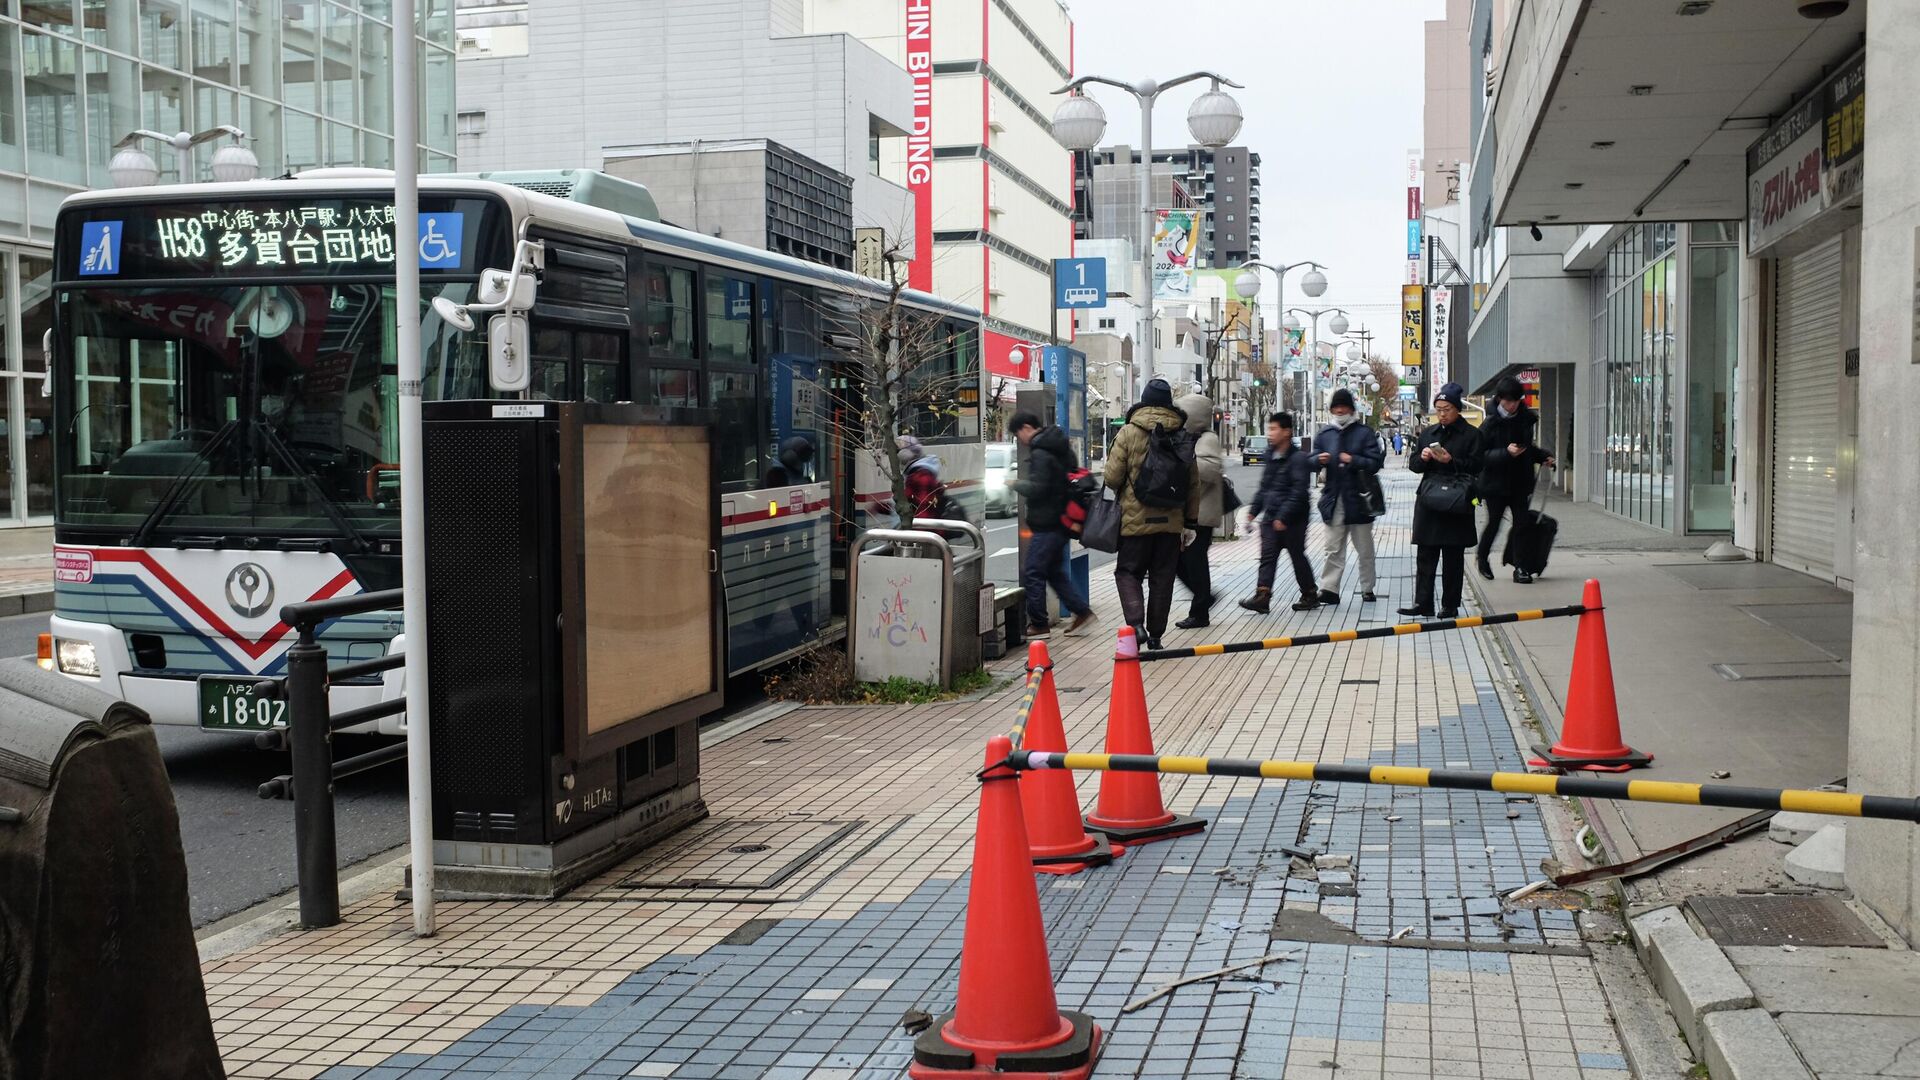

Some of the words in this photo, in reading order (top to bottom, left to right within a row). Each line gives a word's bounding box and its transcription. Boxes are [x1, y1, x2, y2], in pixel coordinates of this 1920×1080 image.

[157, 217, 206, 258] H58
[218, 226, 396, 266] 多賀台団地
[1074, 263, 1086, 285] 1
[208, 704, 217, 715] あ
[223, 695, 287, 727] 18-02
